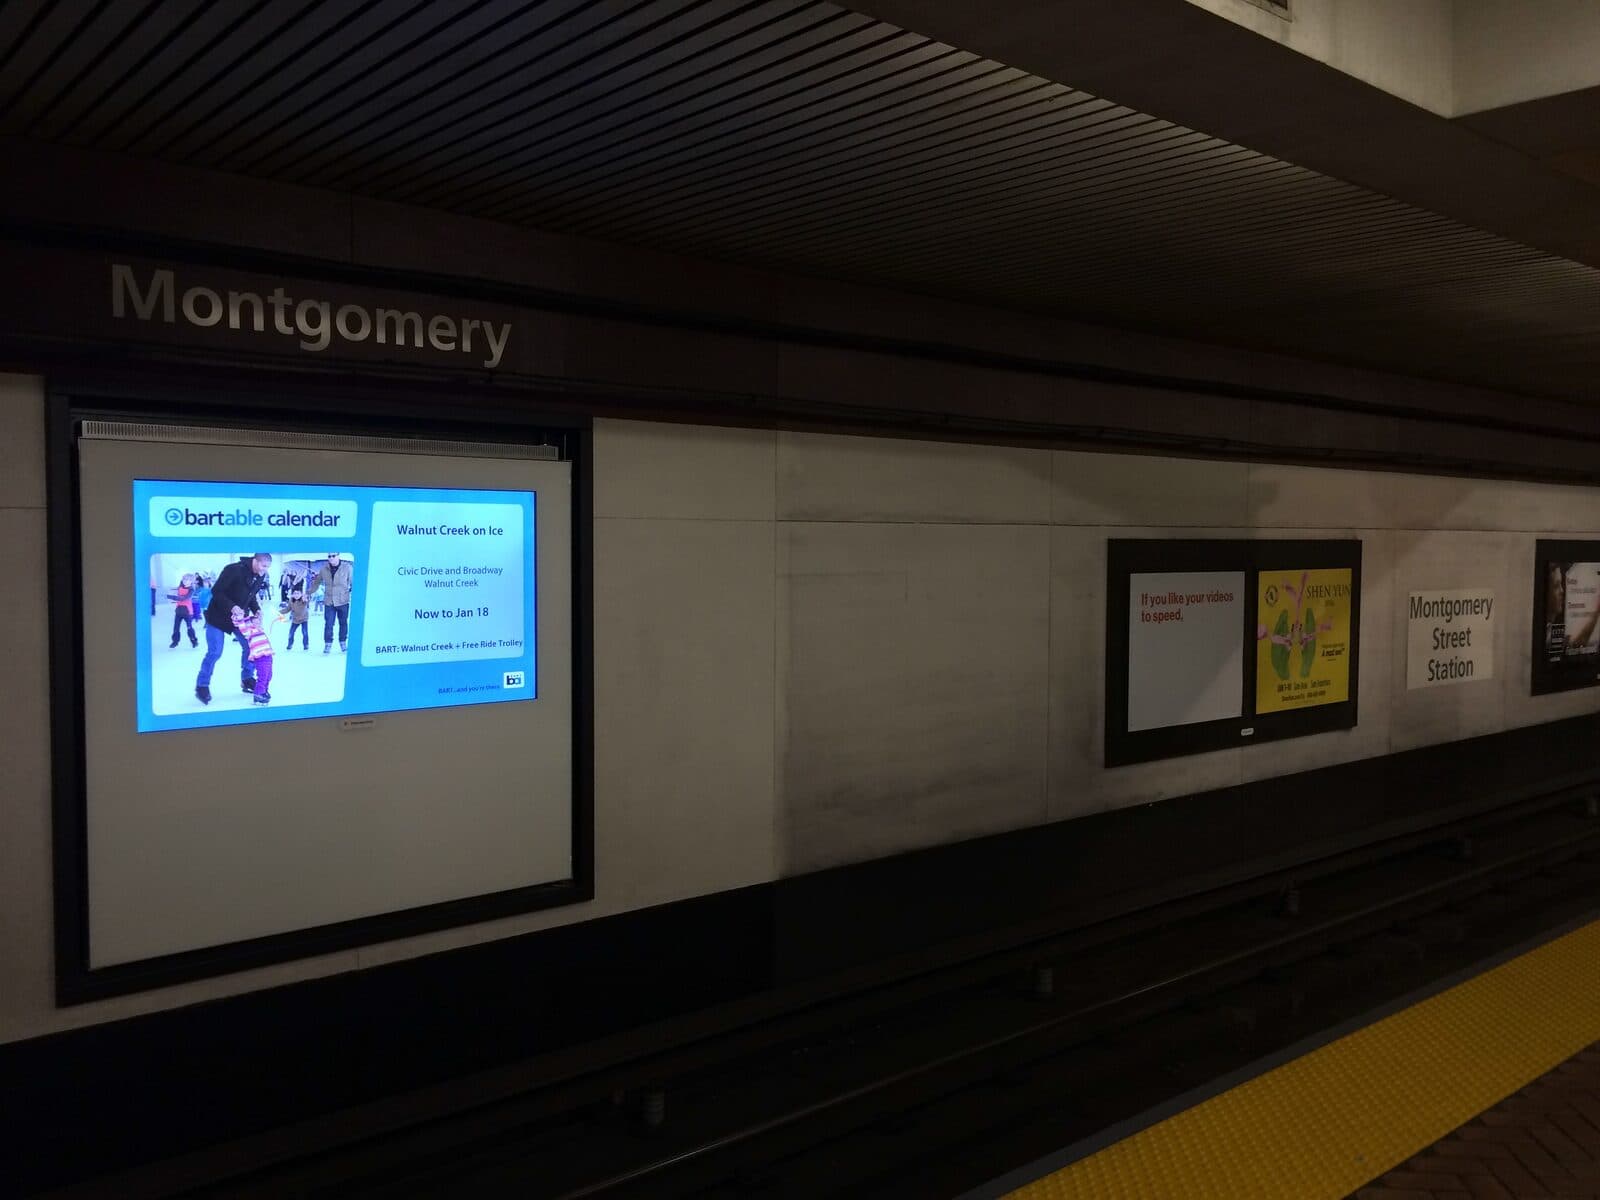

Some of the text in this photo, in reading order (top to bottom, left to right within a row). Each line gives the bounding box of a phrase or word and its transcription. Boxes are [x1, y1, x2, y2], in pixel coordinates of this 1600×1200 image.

[111, 263, 513, 369] Montgomery
[184, 508, 341, 527] bartable calendar
[397, 524, 504, 536] Walnut Creek on Ice
[397, 566, 503, 577] Civic Drive and Broadway
[424, 579, 479, 588] Walnut Creek
[1141, 590, 1234, 608] If you like your videos
[1306, 584, 1331, 599] SHEN
[414, 607, 489, 619] Now to Jan 18
[1141, 608, 1184, 623] to speed,
[1409, 596, 1493, 623] Montgomery
[1432, 627, 1472, 650] Street
[375, 645, 400, 654] BART:
[401, 644, 429, 653] Walnut
[430, 642, 454, 651] Creek
[462, 641, 480, 650] Free
[480, 640, 497, 649] Ride
[498, 639, 523, 649] Trolley
[1428, 656, 1474, 681] Station
